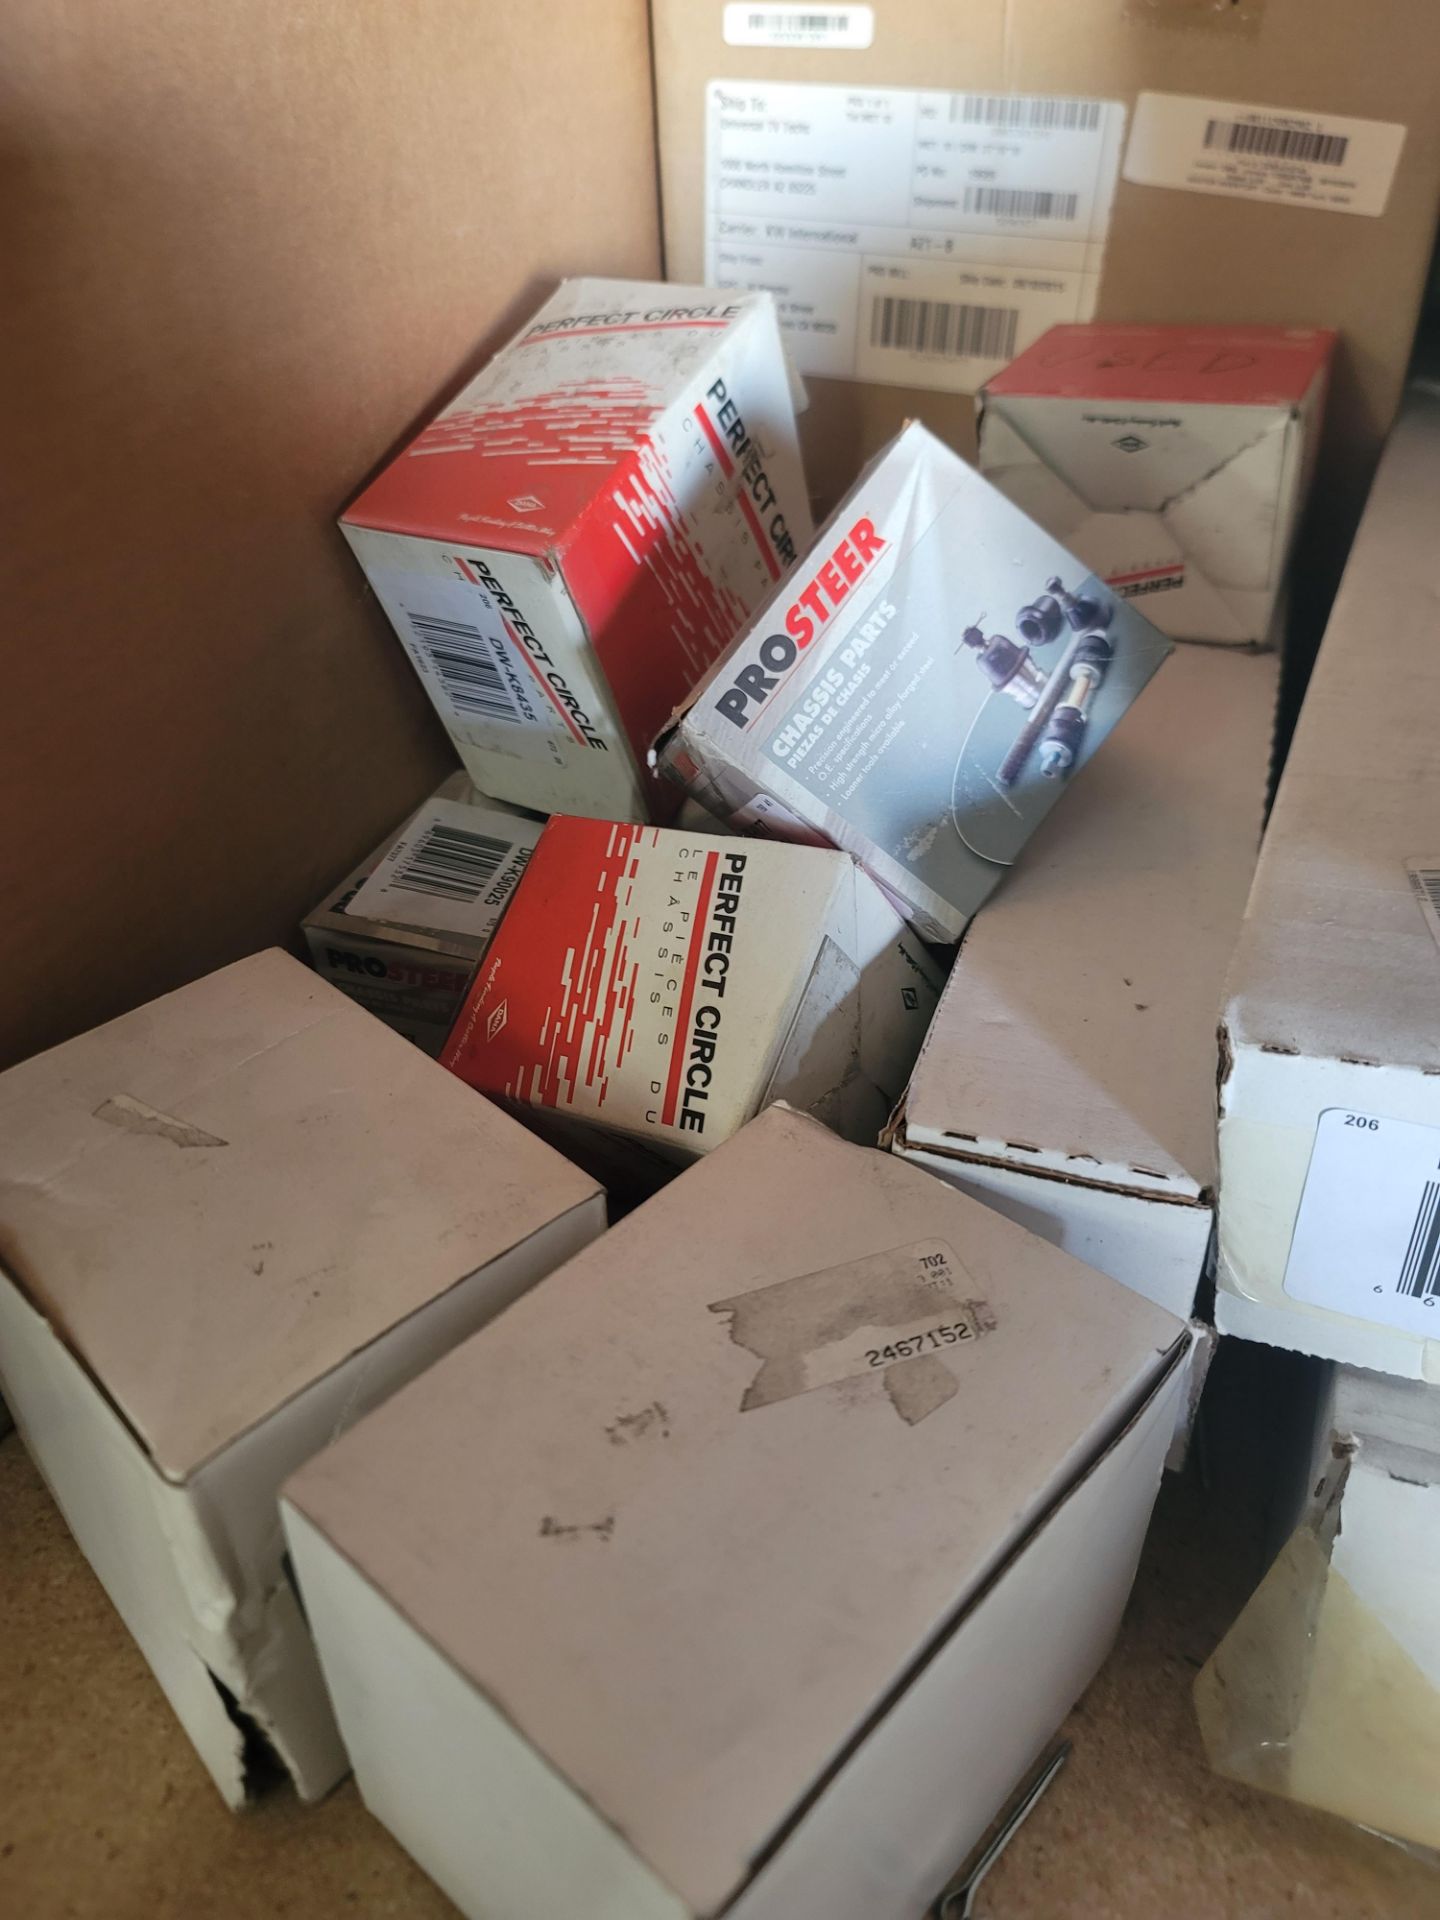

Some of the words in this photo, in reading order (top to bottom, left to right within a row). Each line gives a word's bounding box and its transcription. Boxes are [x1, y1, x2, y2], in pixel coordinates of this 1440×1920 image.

[525, 311, 641, 338] PERFECT
[643, 305, 742, 322] CIRCLE
[768, 513, 798, 569] CIR
[714, 517, 887, 730] PROSTEER
[467, 558, 555, 668] PERFECT
[546, 672, 609, 752] CIRCLE
[488, 636, 538, 722] DW-K8435
[772, 667, 845, 758] CHASSIS
[839, 600, 897, 669] PARTS
[786, 724, 824, 769] PIEZAS
[820, 706, 838, 726] DE
[835, 663, 872, 707] CHASIS
[807, 740, 838, 775] Precision
[835, 695, 871, 741] engineered
[874, 671, 891, 690] meet
[829, 770, 848, 791] High
[845, 740, 870, 772] strength
[868, 719, 887, 742] micro
[885, 699, 903, 721] alloy
[897, 672, 921, 702] forged
[918, 655, 935, 677] steel
[833, 713, 873, 764] specifications
[862, 753, 879, 775] tools
[877, 719, 906, 755] available
[483, 847, 534, 907] DW-K90025
[686, 849, 703, 880] LE
[701, 852, 748, 998] PERFECT
[657, 911, 690, 1046] PIÈCES
[490, 1008, 504, 1032] DANA
[678, 1004, 722, 1134] CIRCLE
[645, 1081, 661, 1124] DU
[1343, 1114, 1380, 1131] 206
[919, 1253, 947, 1270] 702
[1372, 1284, 1383, 1294] 6
[864, 1322, 972, 1368] 2467152
